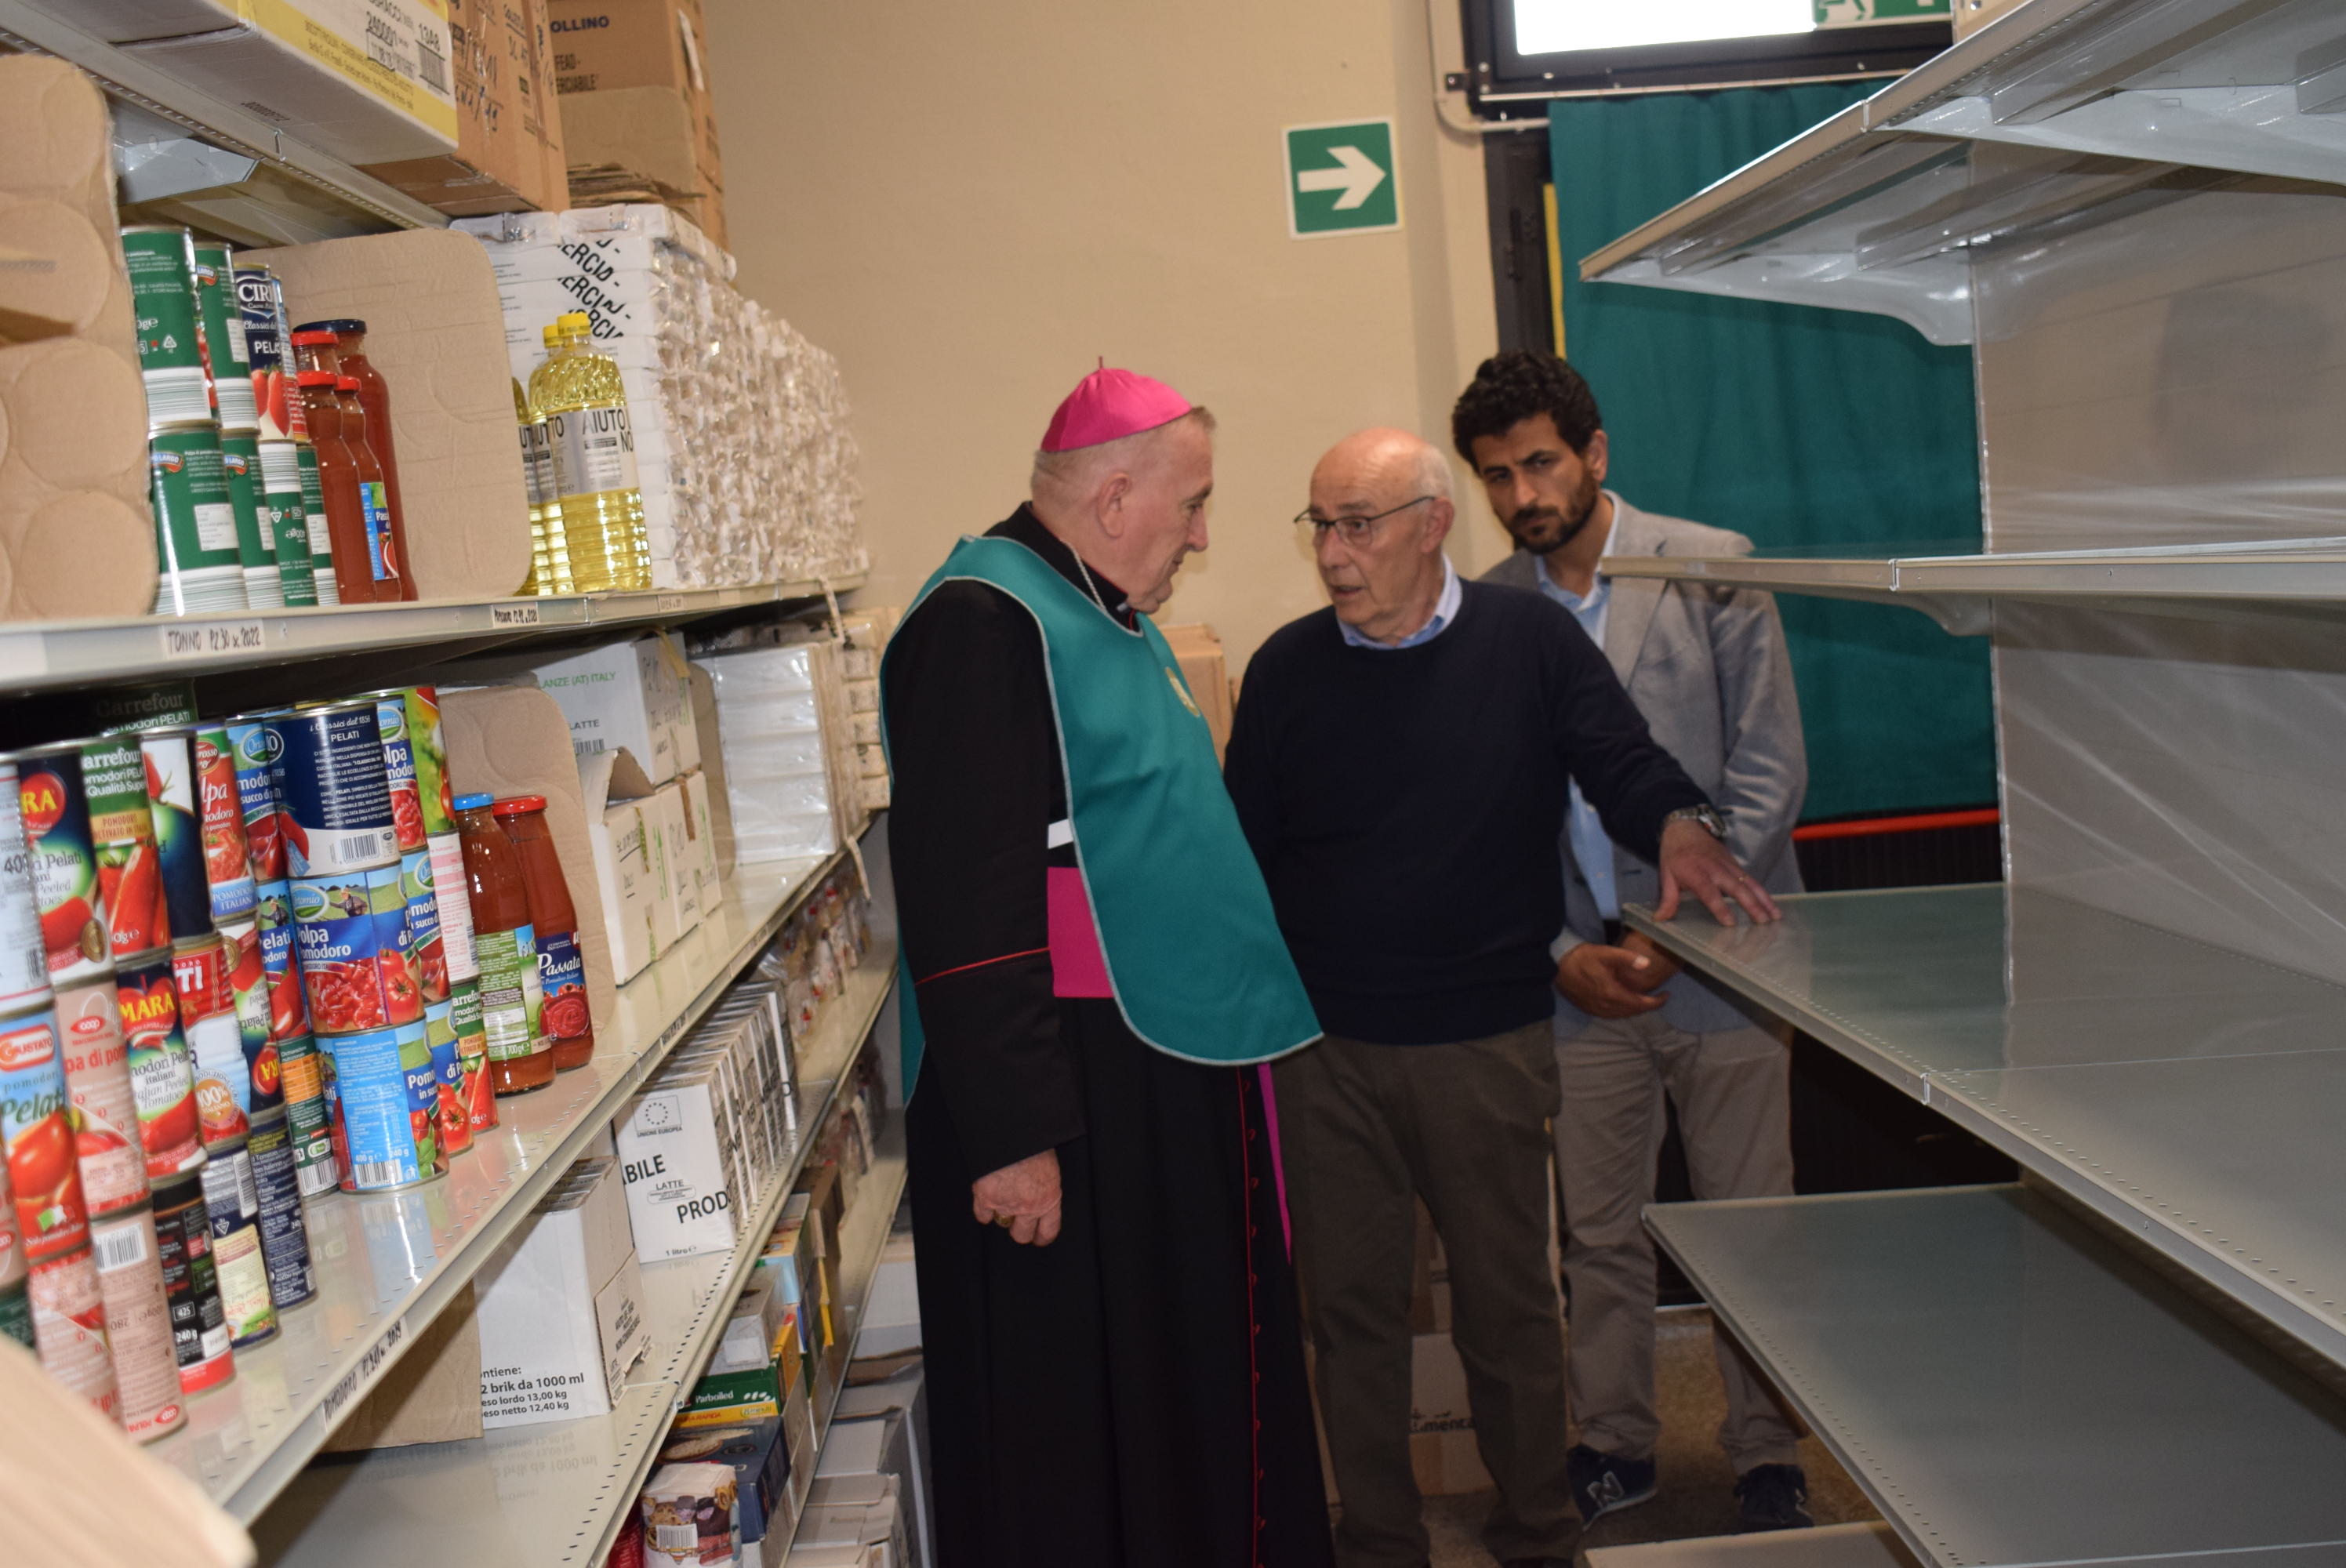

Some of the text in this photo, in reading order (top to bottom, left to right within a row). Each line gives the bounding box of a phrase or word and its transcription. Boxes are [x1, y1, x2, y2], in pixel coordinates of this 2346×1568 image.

[583, 408, 626, 434] AIUTO
[168, 630, 202, 653] TONNO
[241, 626, 260, 647] 2022
[572, 673, 589, 686] (AT)
[590, 671, 616, 683] ITALY
[96, 693, 184, 717] Carrefour
[160, 711, 191, 728] PELATI
[570, 719, 601, 731] LATTE
[330, 730, 360, 742] PELATI
[384, 745, 408, 768] lpa
[87, 783, 126, 798] Qualità
[45, 851, 82, 870] Pelati
[260, 929, 292, 950] elati
[537, 952, 581, 979] Passata
[89, 1047, 104, 1068] di
[197, 1086, 229, 1107] 100%
[658, 1126, 683, 1134] EUROPEA
[656, 1179, 685, 1192] LATTE
[677, 1189, 730, 1225] PROD
[177, 1306, 191, 1317] 425
[176, 1330, 191, 1344] 240
[490, 1381, 516, 1394] brik
[518, 1379, 533, 1390] da
[536, 1375, 566, 1388] 1000
[568, 1372, 585, 1385] ml
[499, 1396, 525, 1405] lordo
[527, 1391, 554, 1402] 13,00
[554, 1390, 568, 1400] kg
[695, 1390, 734, 1404] Parboiled
[502, 1405, 528, 1416] netto
[529, 1402, 555, 1413] 12,40
[557, 1400, 569, 1410] kg
